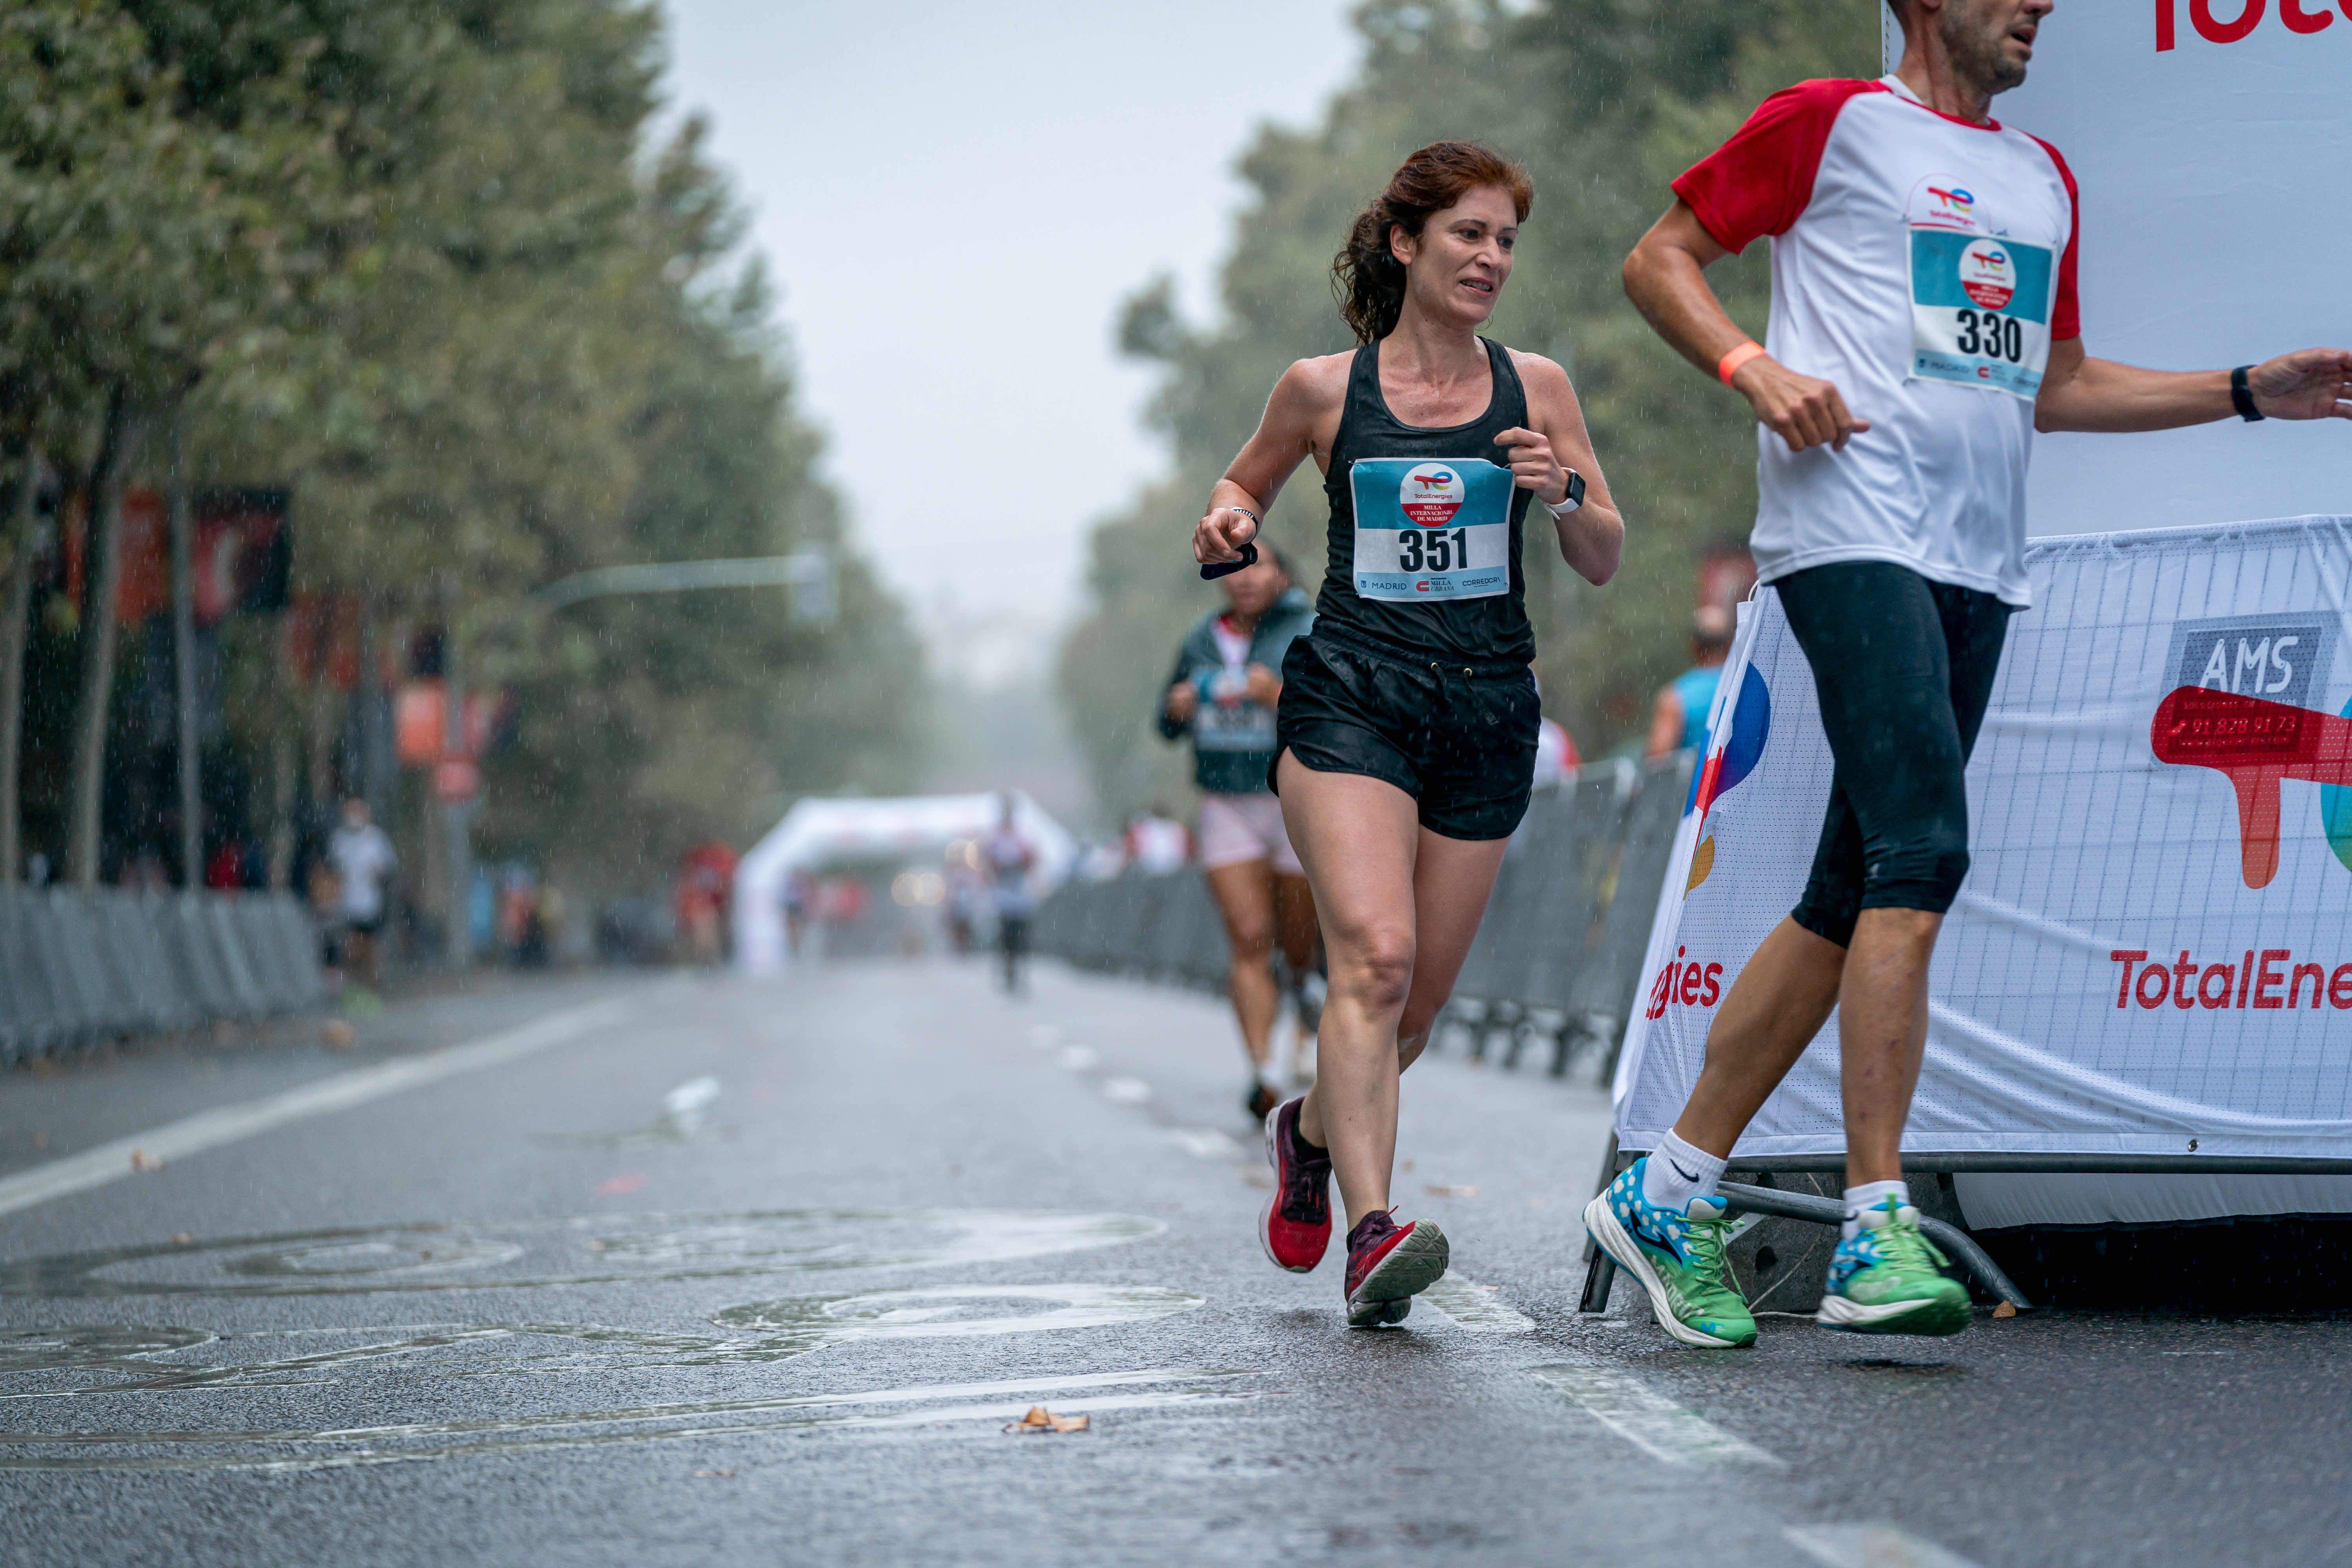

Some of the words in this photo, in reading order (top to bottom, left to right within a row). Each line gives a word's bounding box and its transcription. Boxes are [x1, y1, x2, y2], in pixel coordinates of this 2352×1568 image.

[1956, 309, 2021, 363] 330
[1399, 528, 1468, 572] 351
[2198, 636, 2298, 693] AMS
[2276, 716, 2296, 732] 73
